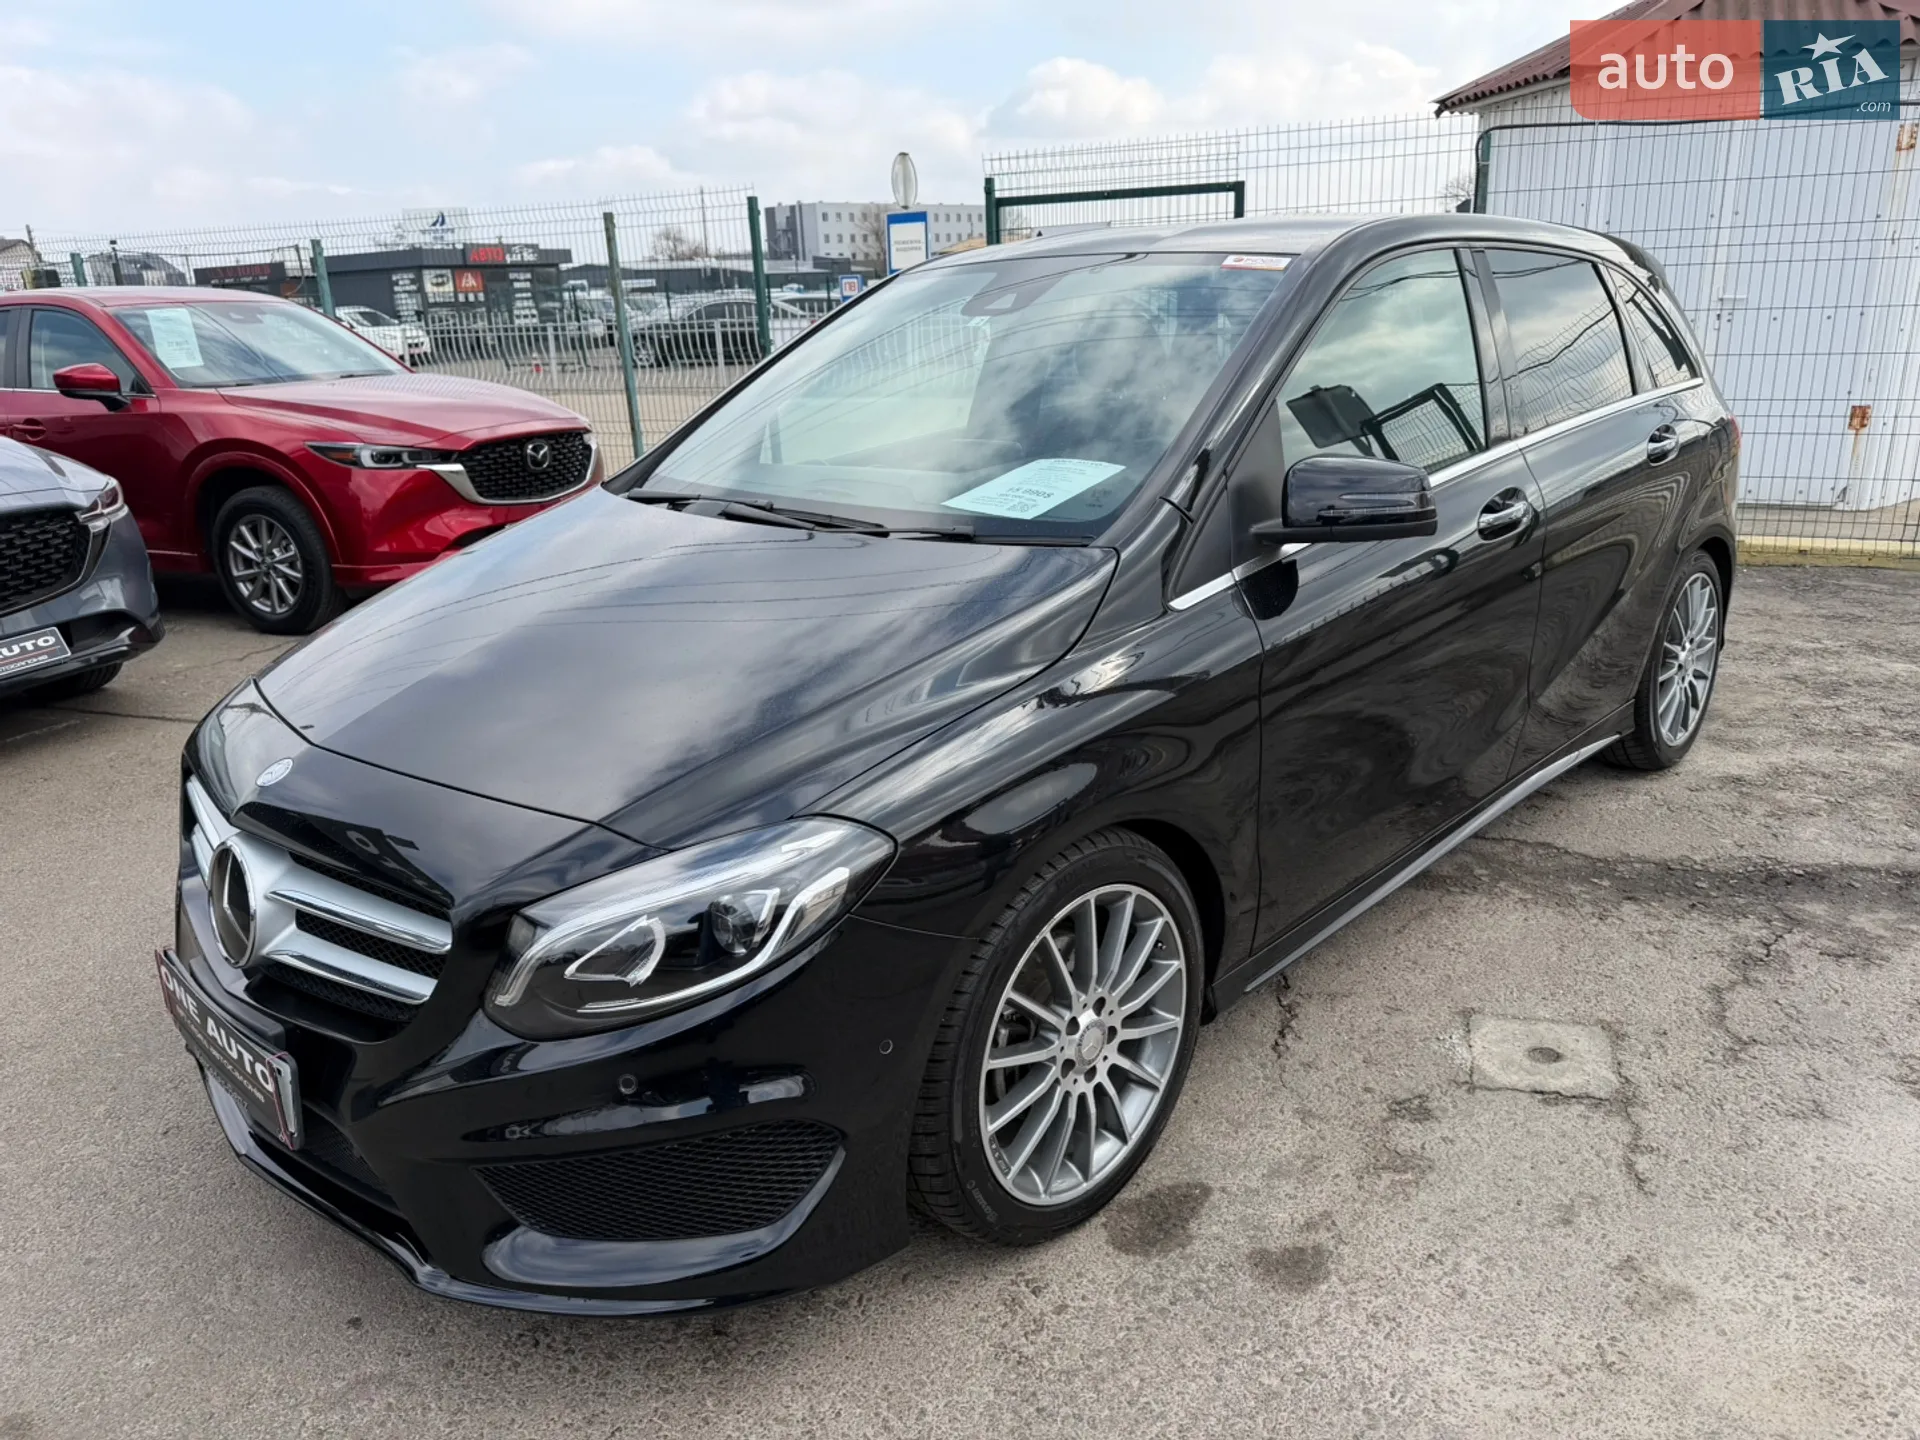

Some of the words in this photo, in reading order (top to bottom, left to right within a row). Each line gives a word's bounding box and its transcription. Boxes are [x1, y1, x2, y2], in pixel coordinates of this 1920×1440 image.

[469, 247, 504, 263] АВТО
[0, 636, 56, 658] UTO
[160, 965, 201, 1024] ONE
[206, 1015, 275, 1093] AUTO
